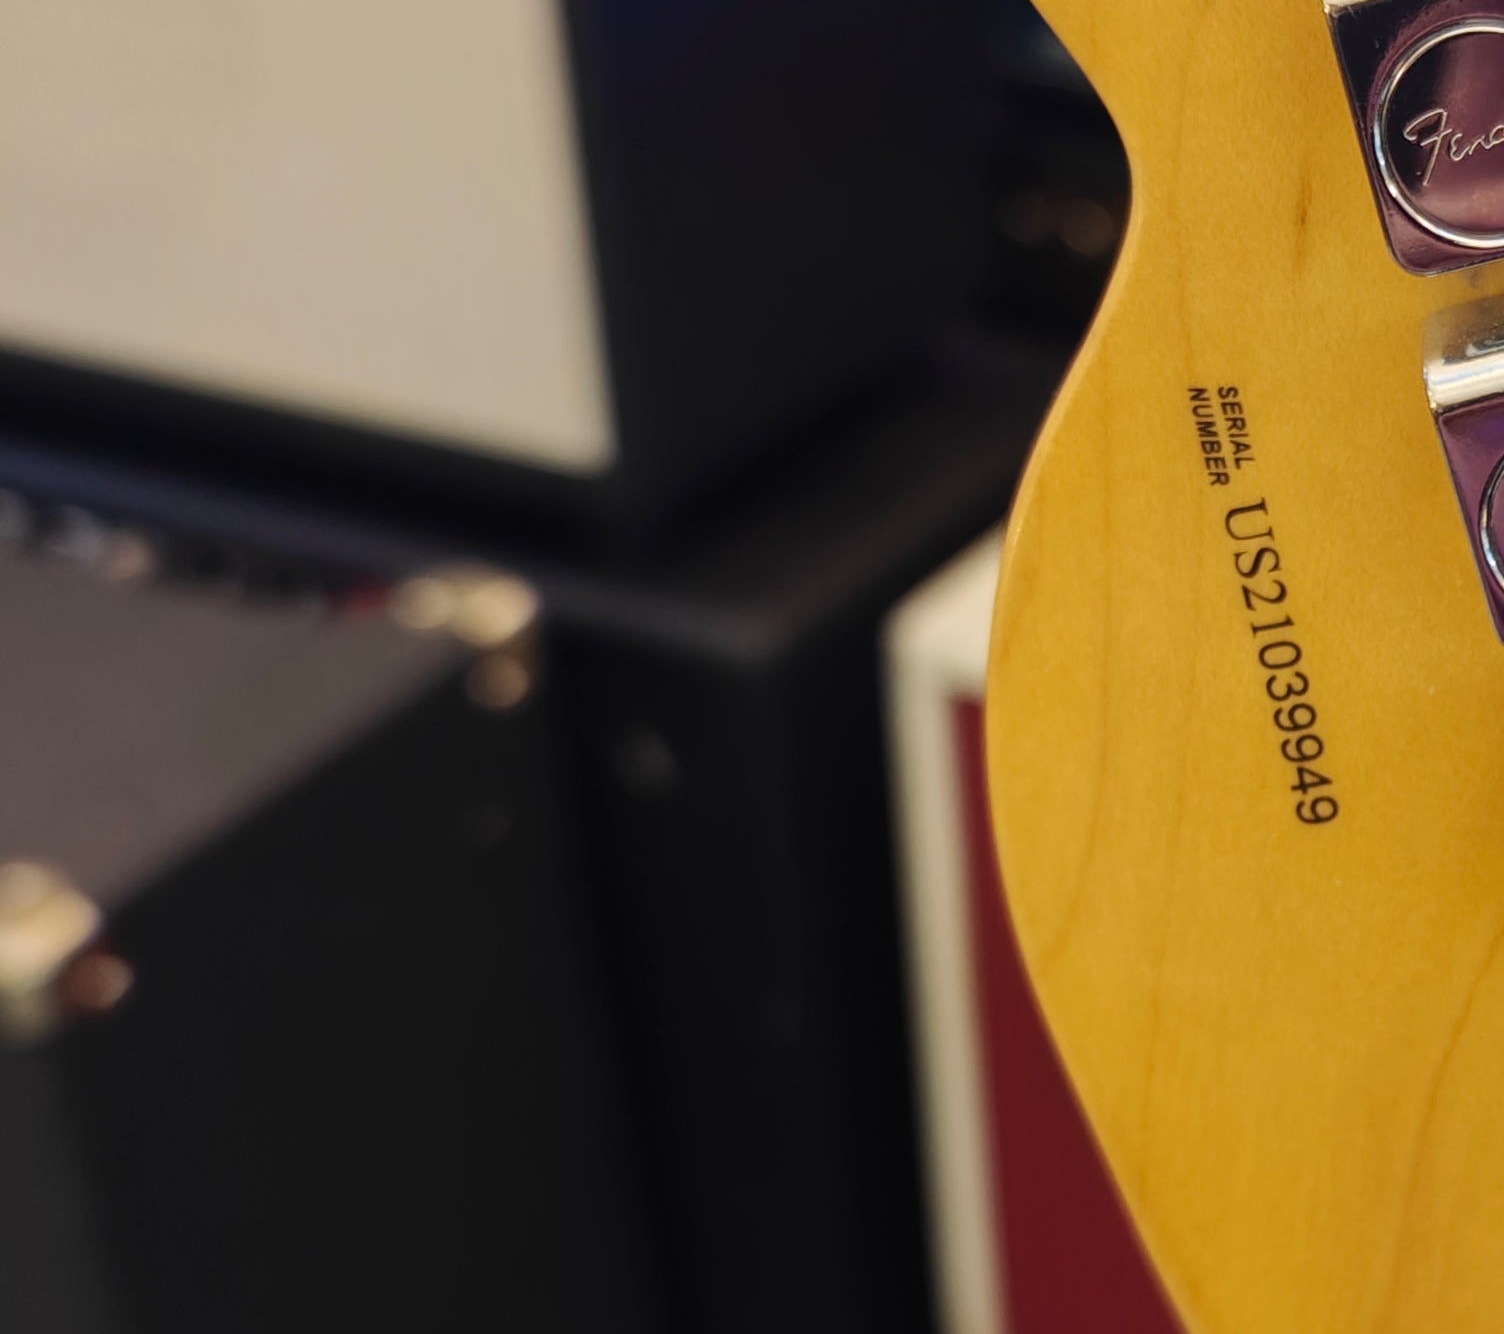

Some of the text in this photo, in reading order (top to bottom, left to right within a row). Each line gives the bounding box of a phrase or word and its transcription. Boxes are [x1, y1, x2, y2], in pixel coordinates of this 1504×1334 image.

[1187, 387, 1229, 487] NUMBER
[1217, 386, 1256, 469] SERIAL
[1224, 496, 1340, 827] US21039949
